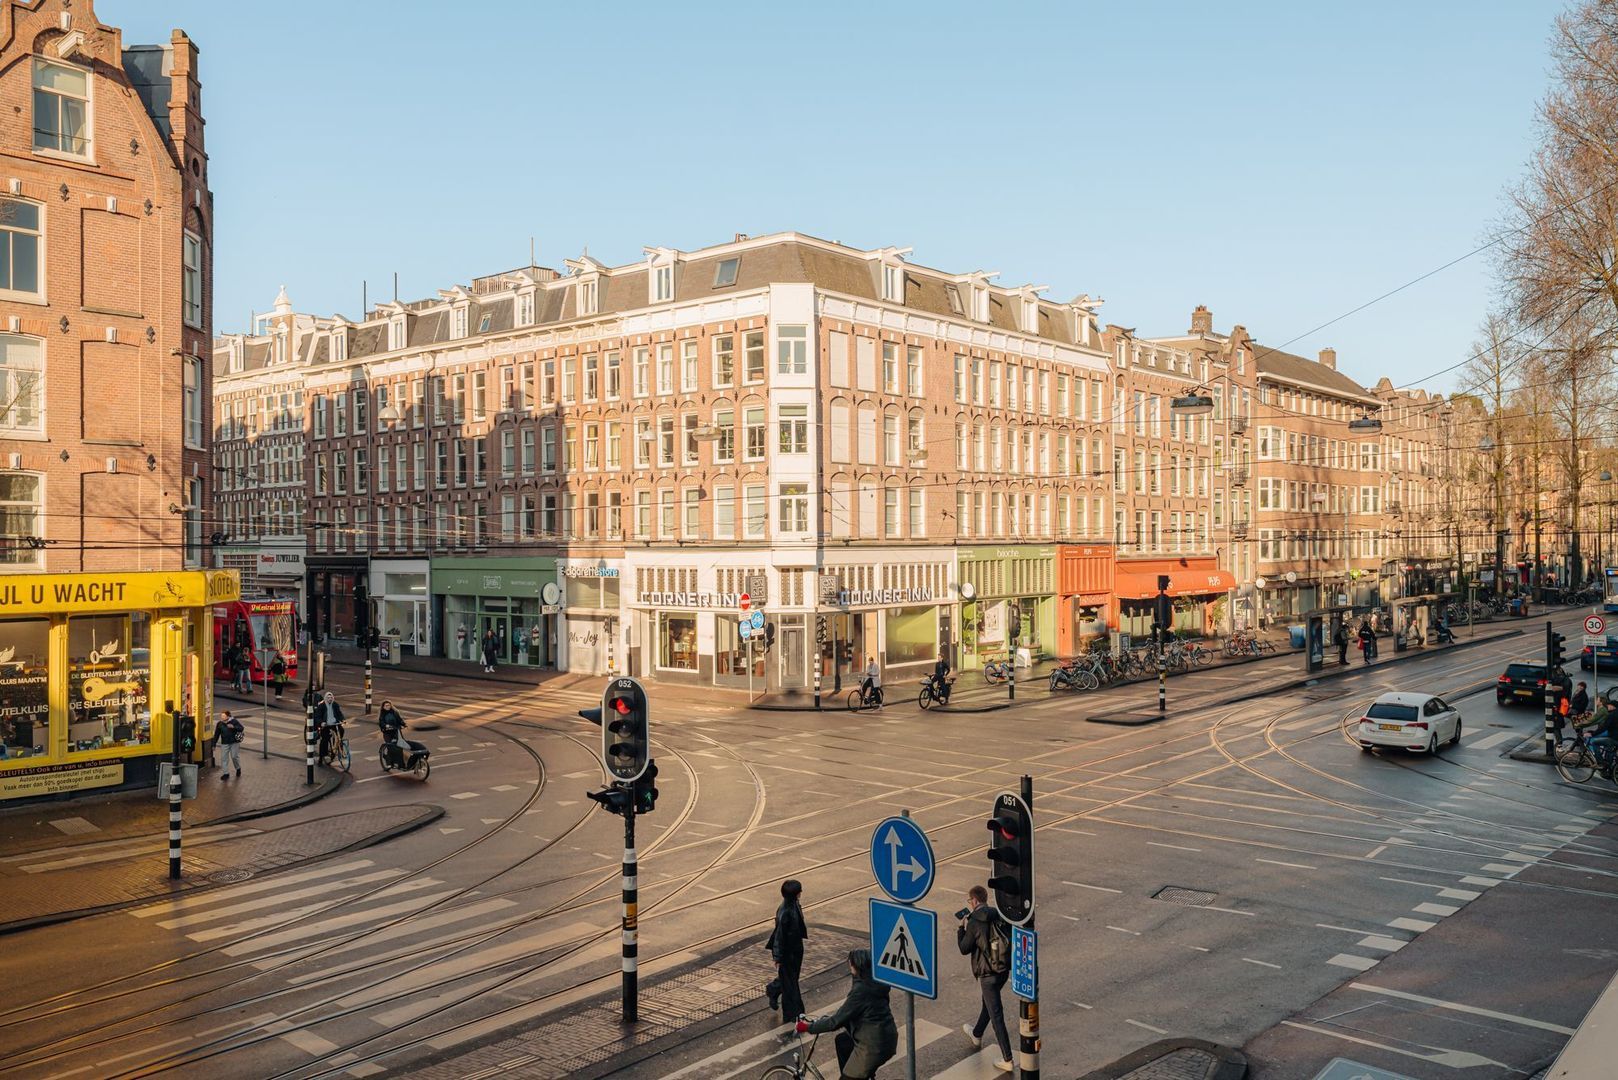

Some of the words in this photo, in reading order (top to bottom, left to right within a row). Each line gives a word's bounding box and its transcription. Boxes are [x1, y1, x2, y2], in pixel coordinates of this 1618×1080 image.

[31, 585, 44, 604] U
[54, 583, 126, 603] WACHT
[841, 588, 903, 605] CORNER
[906, 587, 931, 602] INN
[641, 592, 711, 607] CORNER
[1588, 621, 1601, 629] 30
[80, 670, 122, 679] SLEUTELKLUIS
[618, 680, 632, 688] 052
[69, 702, 82, 710] DE
[84, 696, 147, 709] SLEUTELKLUIS
[56, 776, 84, 786] goedkoper
[1003, 795, 1016, 807] 051
[1021, 983, 1032, 993] OP
